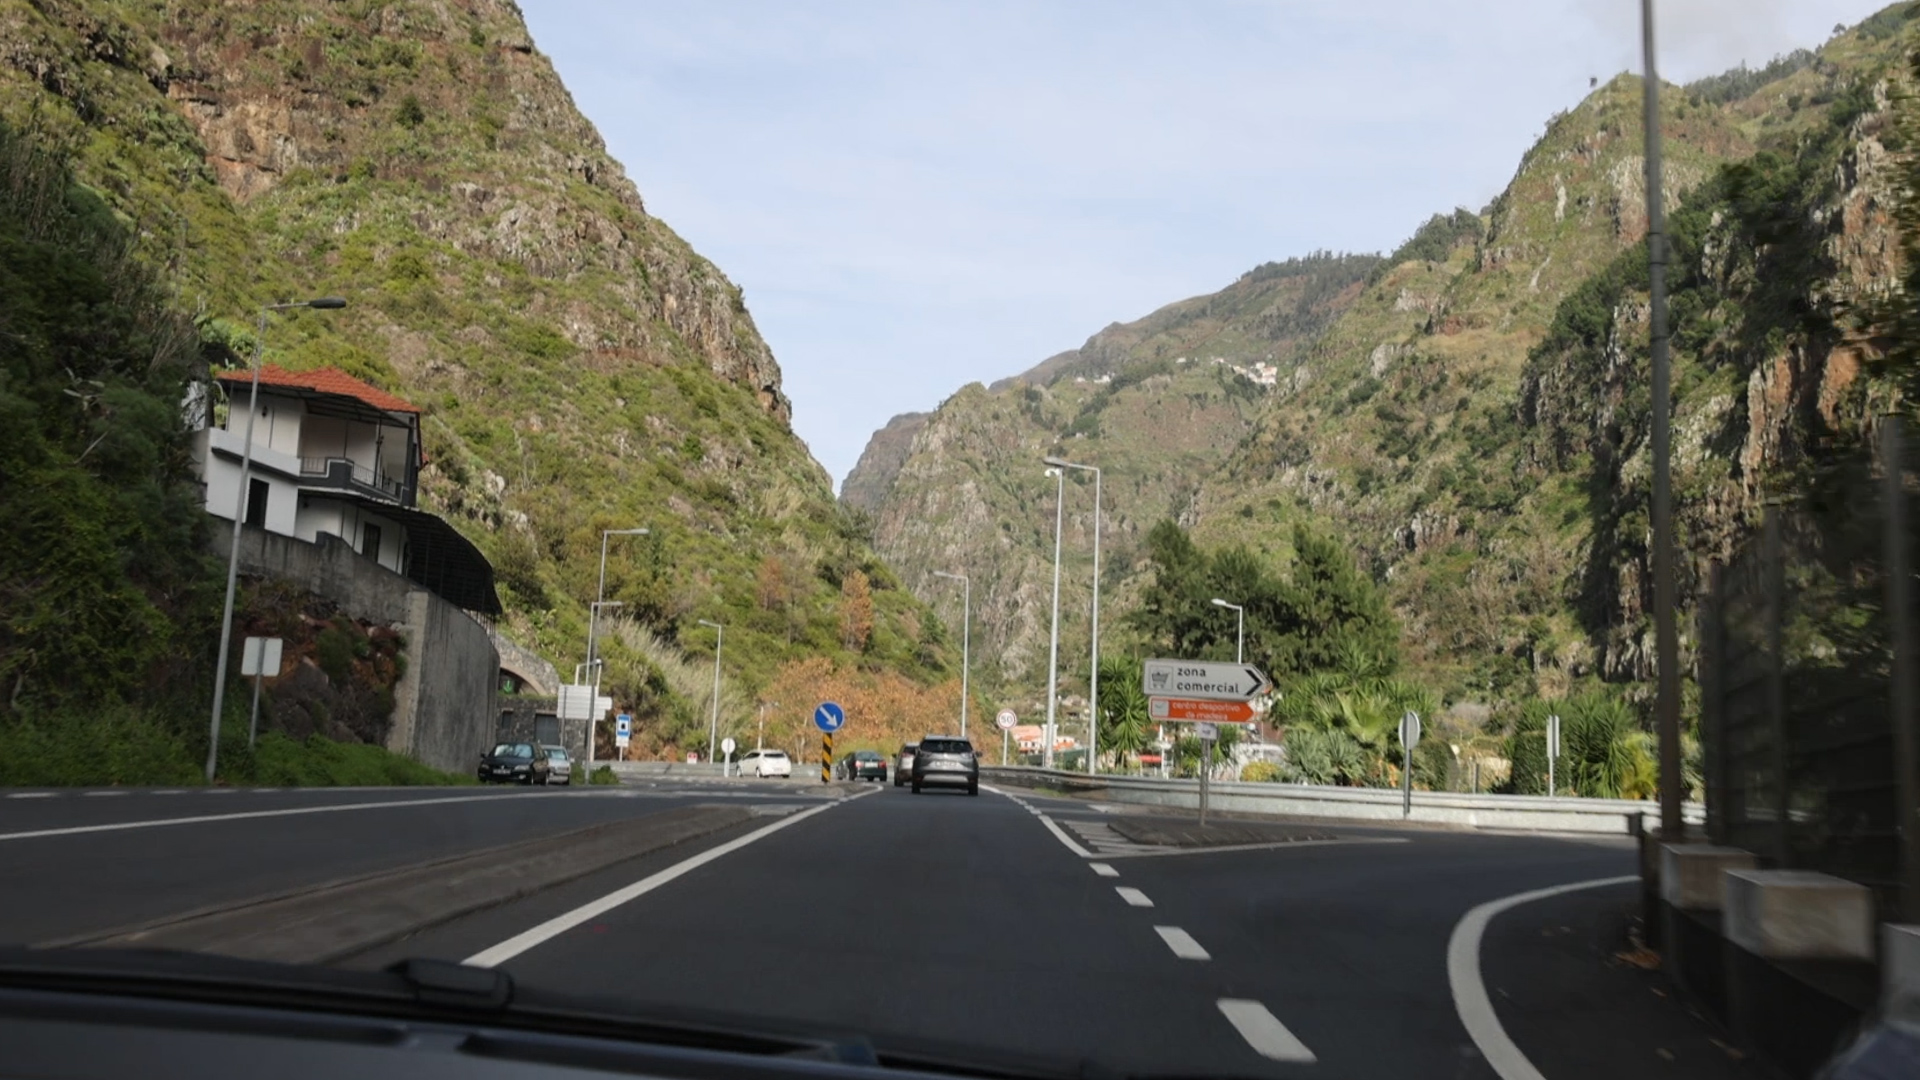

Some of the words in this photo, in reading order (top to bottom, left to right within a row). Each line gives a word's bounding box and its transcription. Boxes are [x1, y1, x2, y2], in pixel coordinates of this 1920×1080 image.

[1177, 667, 1206, 677] zona
[1176, 681, 1239, 693] comercial
[1172, 701, 1197, 710] centro
[1199, 702, 1241, 712] desportivo
